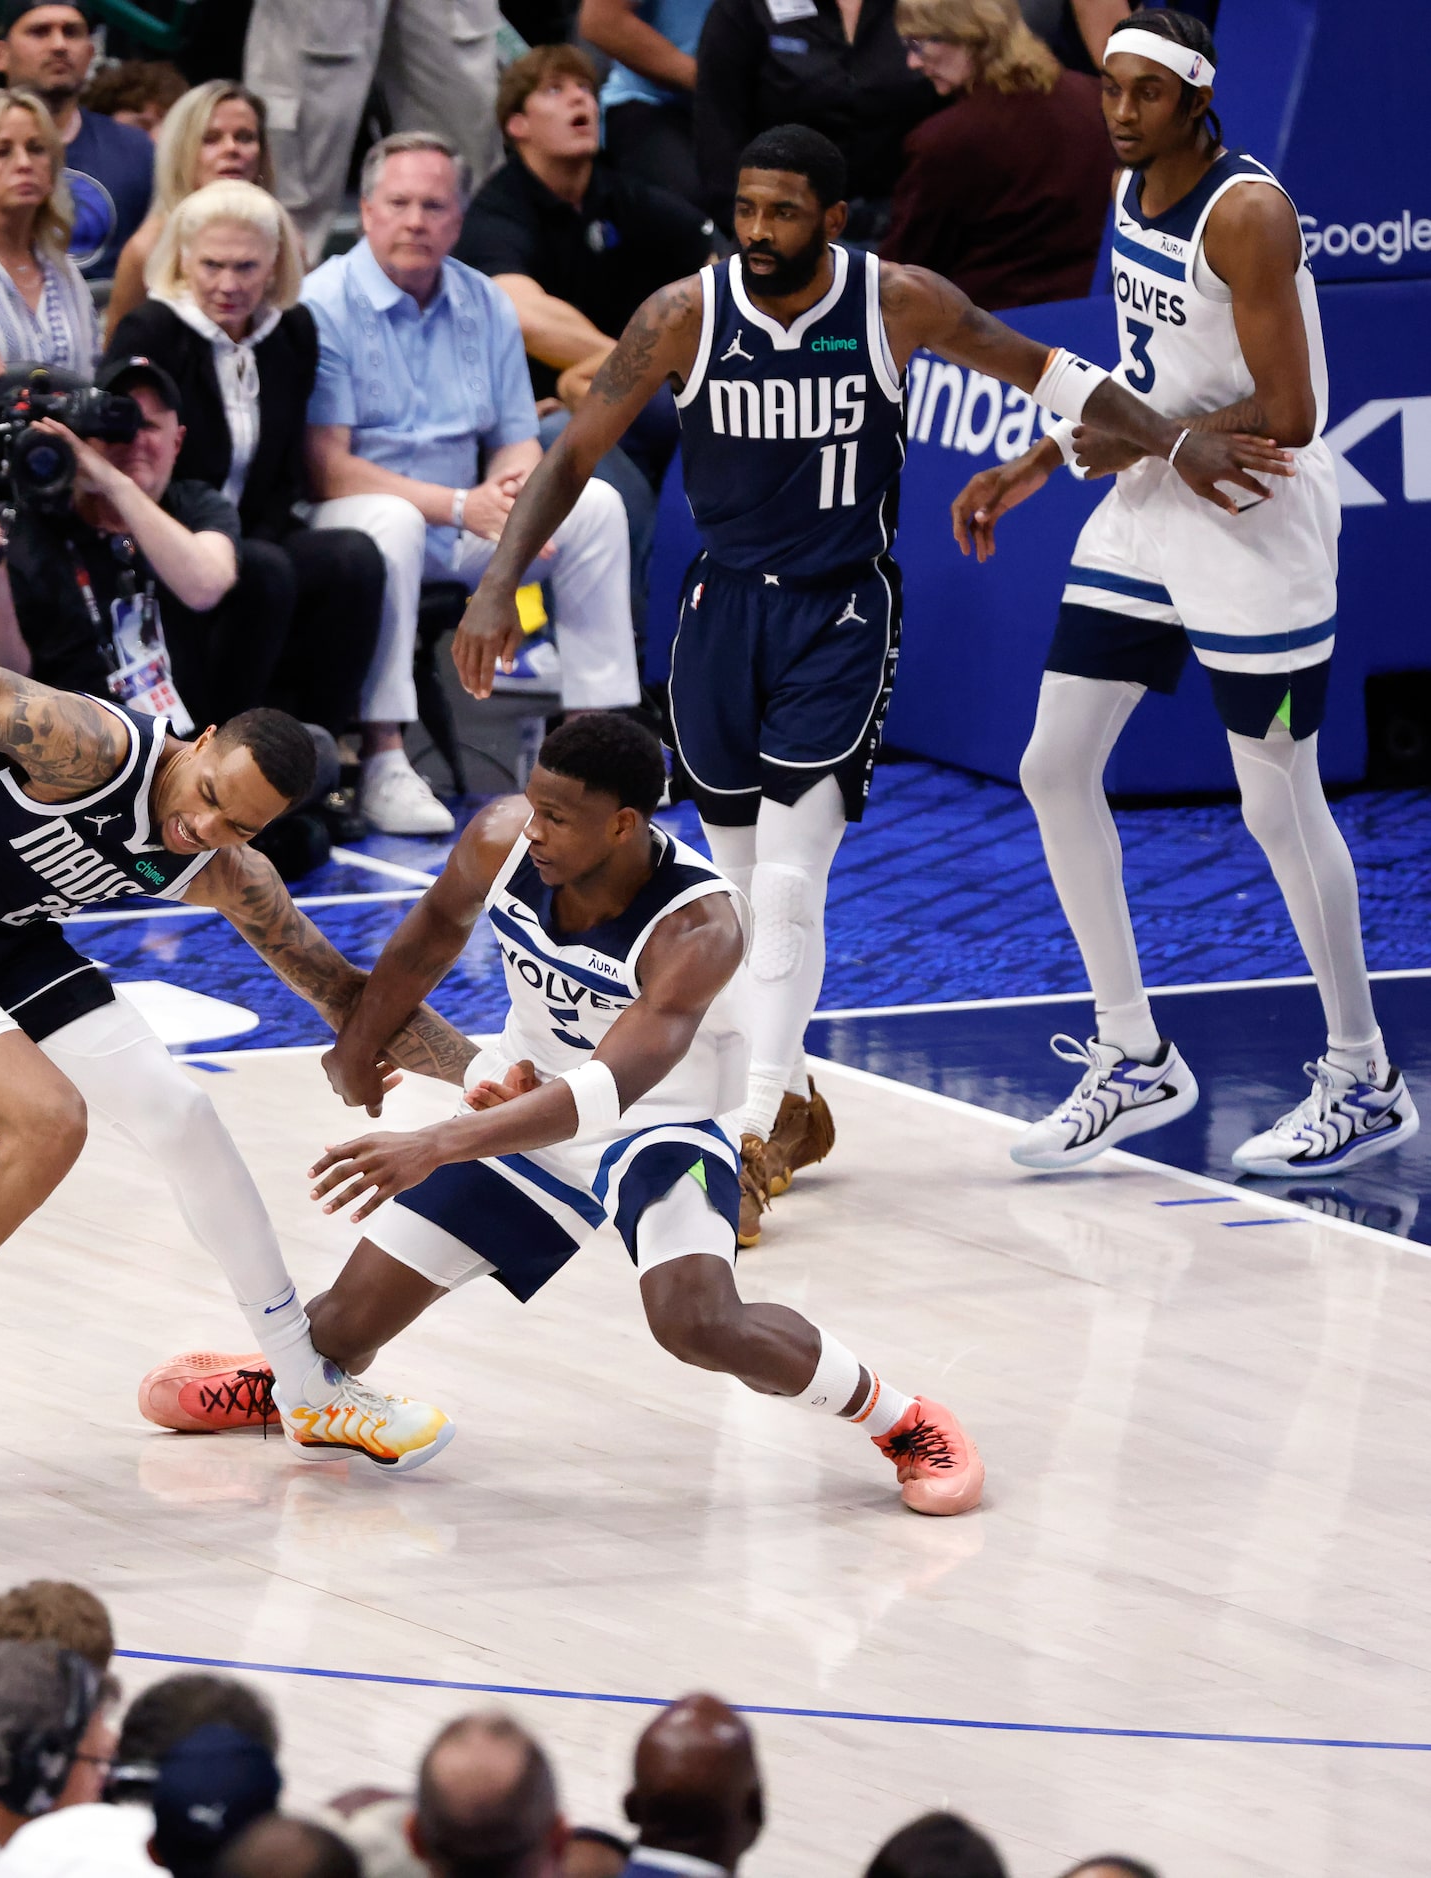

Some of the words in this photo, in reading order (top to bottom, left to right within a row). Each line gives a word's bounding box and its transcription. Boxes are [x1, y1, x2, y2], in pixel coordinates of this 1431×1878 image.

[1299, 209, 1431, 266] Google
[1114, 266, 1187, 327] OLVES
[811, 336, 858, 352] chime
[1125, 316, 1156, 394] 3
[709, 375, 867, 439] MAVS
[819, 441, 859, 510] 11
[135, 860, 166, 886] chime
